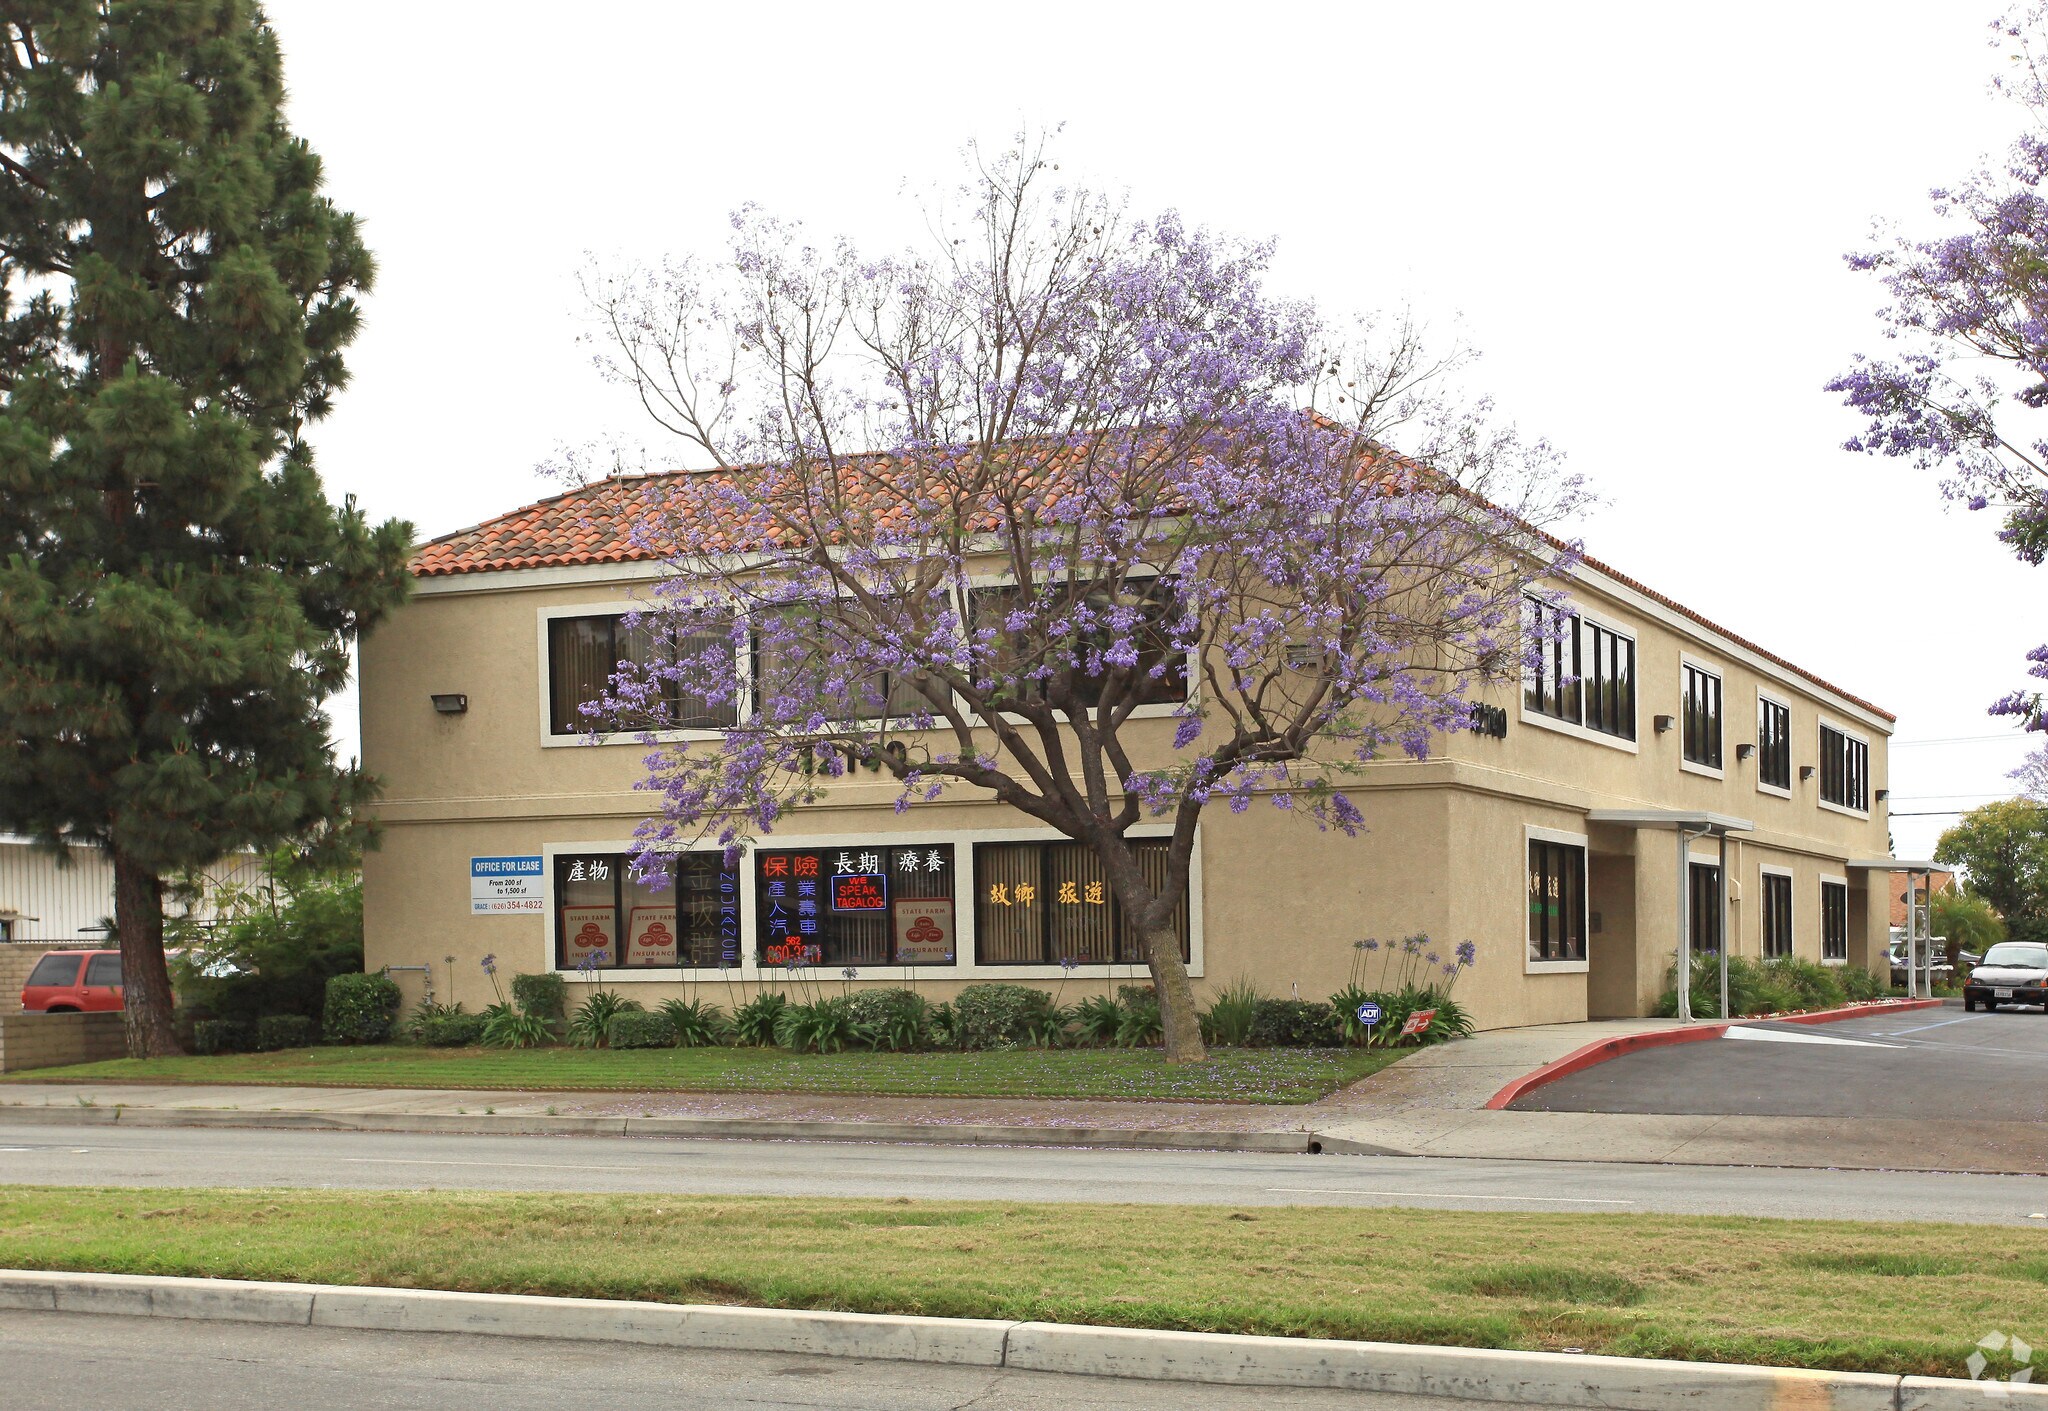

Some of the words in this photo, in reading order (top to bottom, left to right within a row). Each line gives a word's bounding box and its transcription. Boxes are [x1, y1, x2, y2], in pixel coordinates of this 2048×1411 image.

[475, 862, 500, 872] OFFICE
[502, 861, 516, 871] FOR
[517, 861, 540, 871] LEASE
[764, 856, 819, 877] 保險
[834, 851, 879, 874] 長期
[899, 849, 945, 873] 療養
[567, 860, 609, 881] 產物
[505, 887, 520, 895] 1,500
[768, 880, 816, 897] 產業
[839, 885, 876, 896] SPEAK
[990, 882, 1035, 908] 故鄉
[769, 899, 817, 917] 人壽
[836, 896, 883, 908] TAGALOG
[719, 870, 737, 960] NSURANCE
[769, 919, 818, 936] 汽車
[786, 936, 801, 945] 562
[1361, 1009, 1378, 1018] ADT
